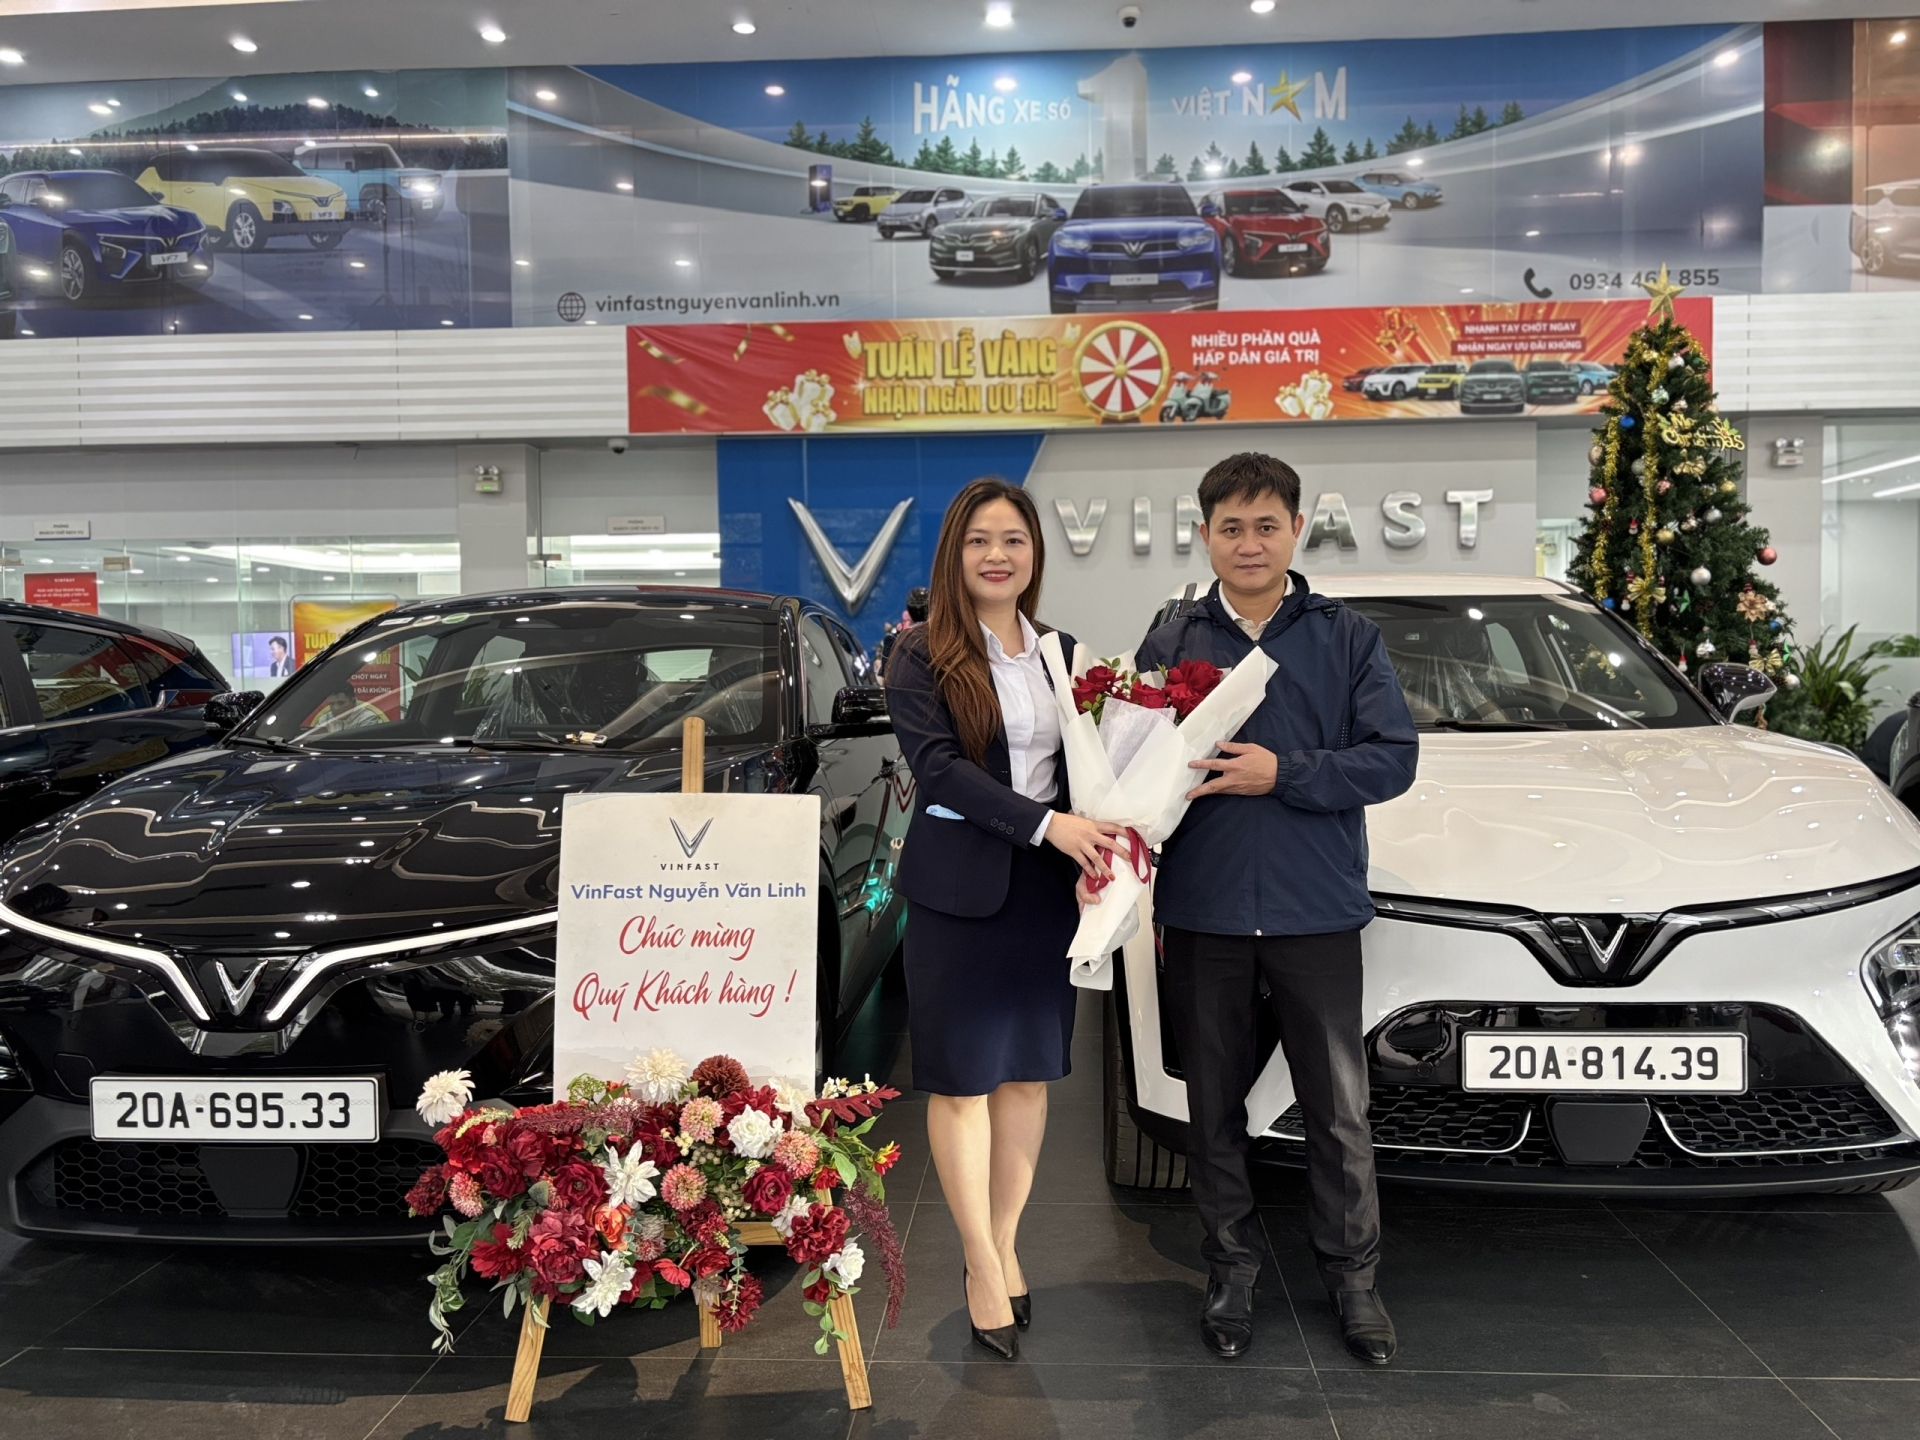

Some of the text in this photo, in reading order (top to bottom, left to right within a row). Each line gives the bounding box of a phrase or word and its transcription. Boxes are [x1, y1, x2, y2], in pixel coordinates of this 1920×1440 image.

[913, 74, 1006, 135] HÃNG
[1013, 98, 1042, 124] XE
[1172, 86, 1232, 121] VIỆT
[1569, 272, 1624, 291] 0934
[1678, 268, 1719, 287] 855
[595, 291, 840, 314] vinfastnguyenvanlinh.vn
[1191, 328, 1321, 348] NHIỀU PHẦN QUÀ
[1464, 324, 1499, 335] NHANH
[1501, 324, 1520, 334] TAY
[1549, 321, 1577, 332] NGAY
[941, 327, 976, 378] LỄ
[981, 328, 1058, 378] VÀNG
[1193, 348, 1225, 366] HẤP
[1264, 346, 1292, 364] GIÁ
[1294, 348, 1320, 365] TRỊ
[1486, 341, 1513, 352] NGAY
[863, 375, 1058, 420] NHẬN NGÀN ƯU ĐÃI
[1054, 488, 1495, 556] VINAST
[660, 863, 720, 871] VINFAST
[571, 881, 806, 902] VinFast Nguyễn Văn Linh
[618, 915, 755, 961] Chúc mừng
[572, 972, 630, 1022] Quý
[633, 969, 713, 1012] Khách
[718, 970, 775, 1018] hàng
[1489, 1045, 1719, 1081] 20A-814.39
[116, 1091, 351, 1129] 20A-695.33
